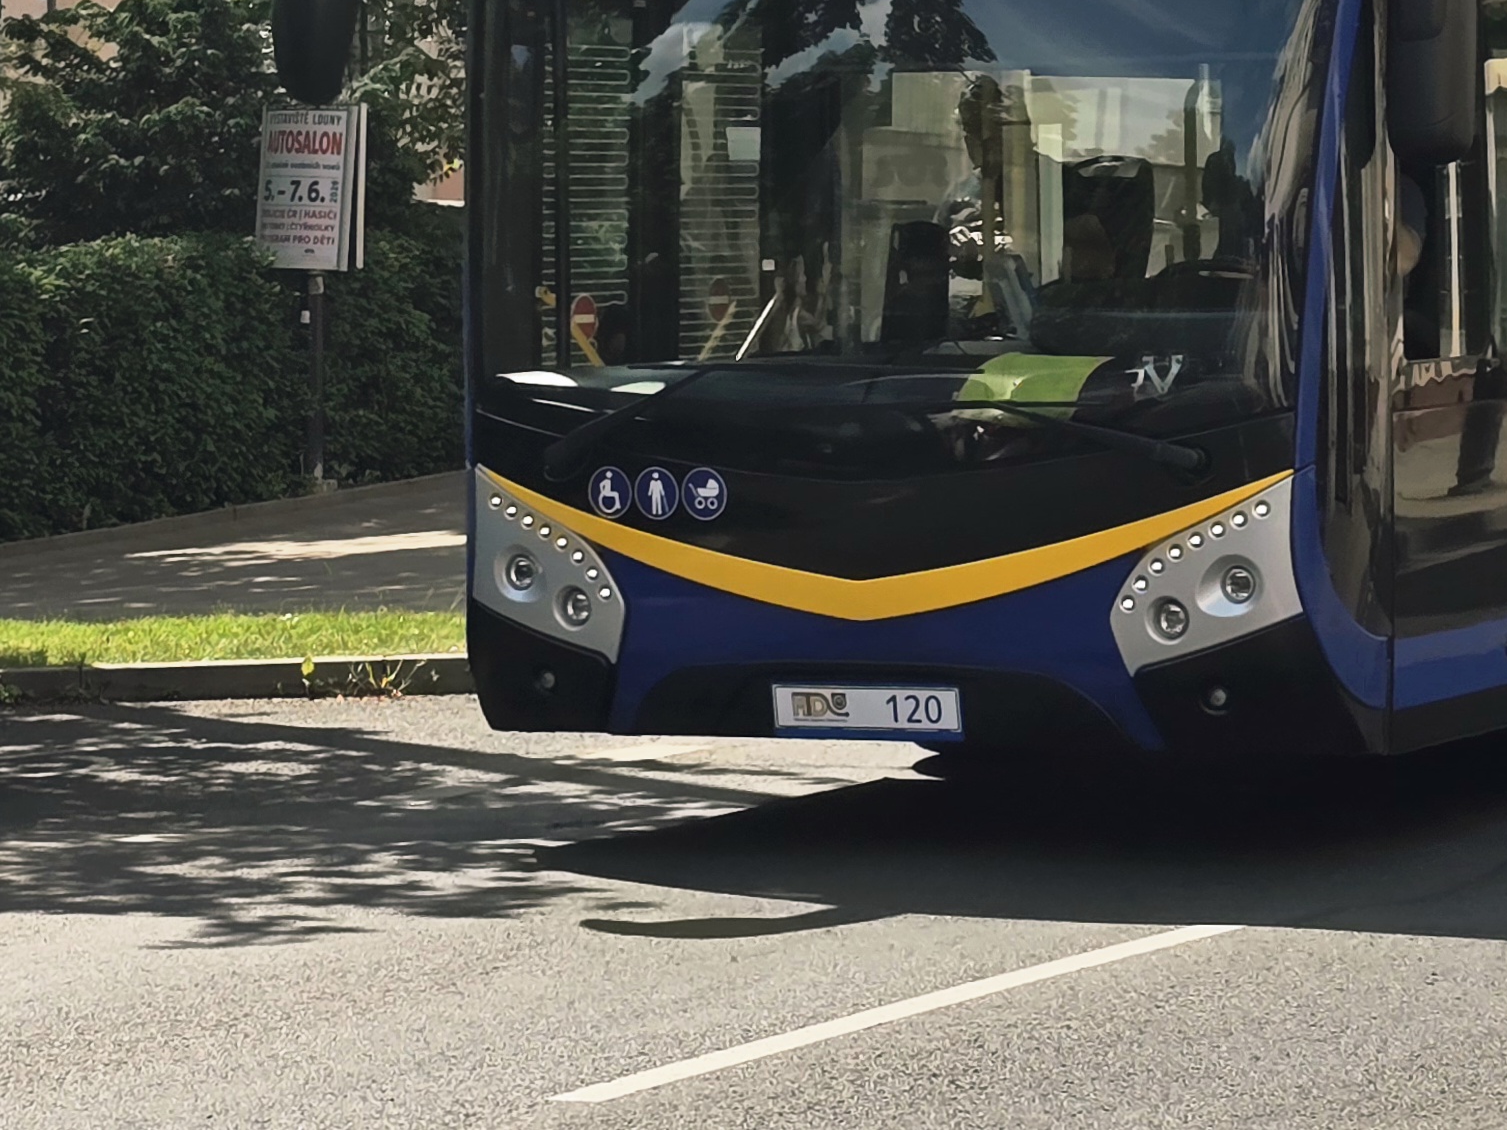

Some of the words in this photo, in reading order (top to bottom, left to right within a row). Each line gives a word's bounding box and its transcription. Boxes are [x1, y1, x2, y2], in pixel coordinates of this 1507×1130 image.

[313, 113, 342, 127] LOUNY
[267, 129, 343, 156] AUTOSALON
[886, 694, 943, 724] 120
